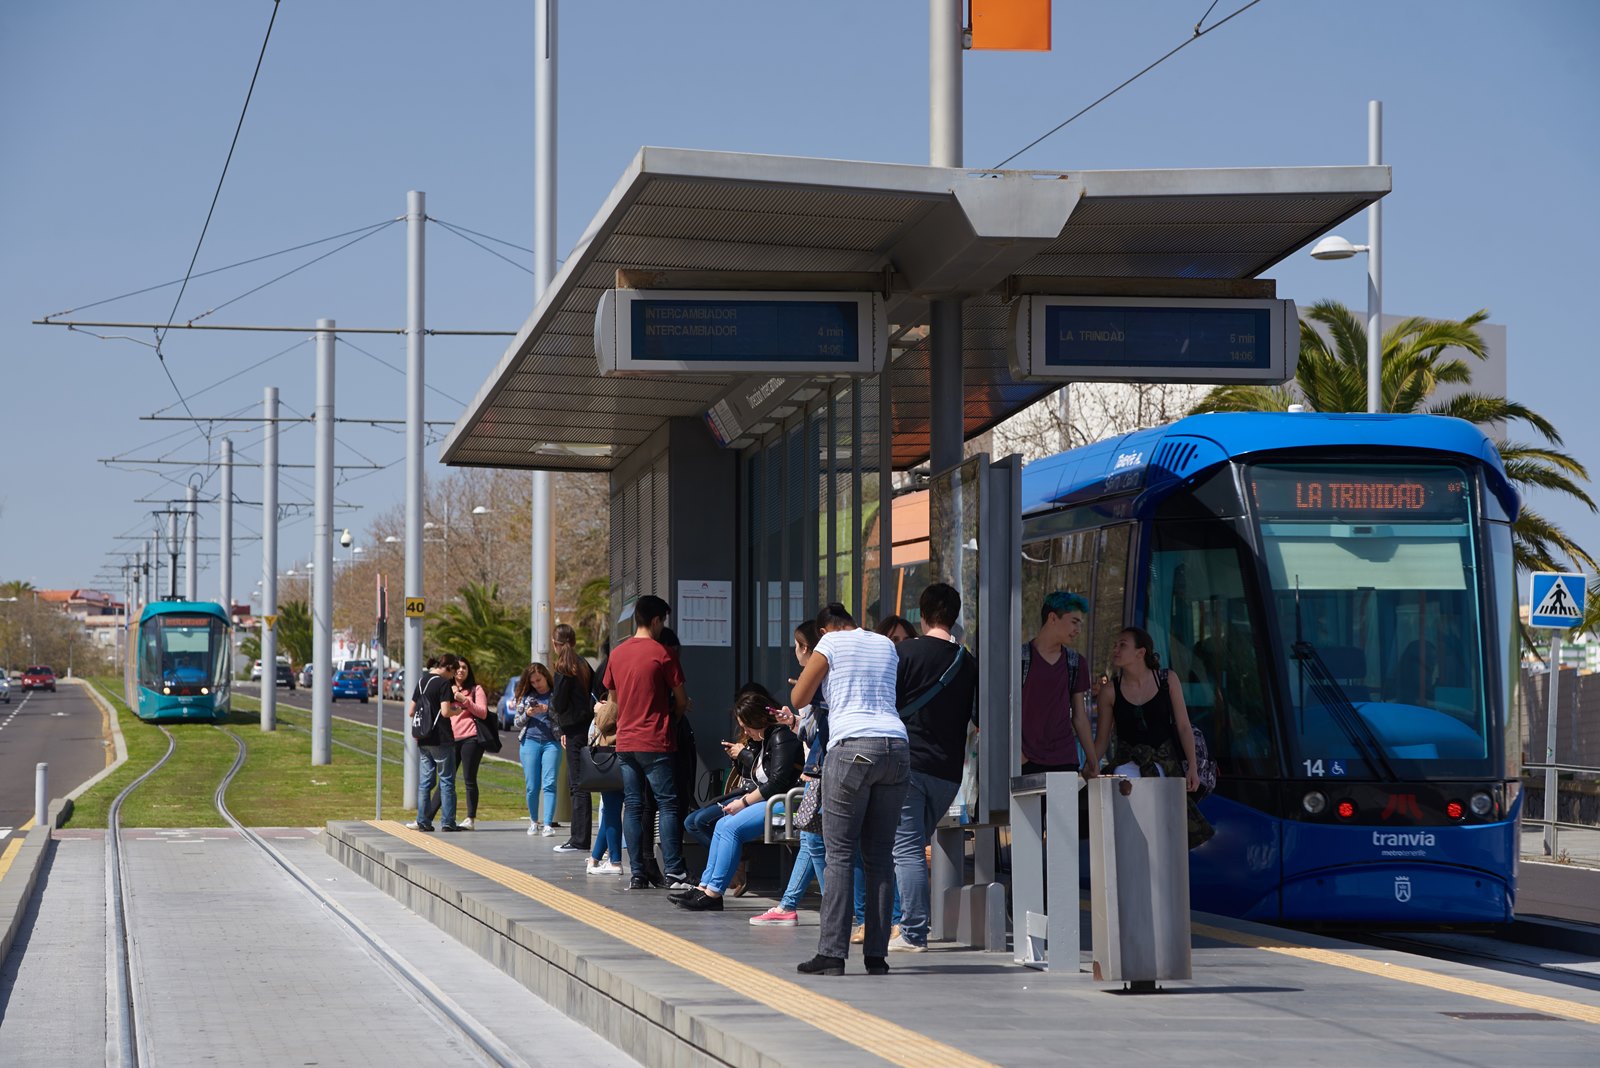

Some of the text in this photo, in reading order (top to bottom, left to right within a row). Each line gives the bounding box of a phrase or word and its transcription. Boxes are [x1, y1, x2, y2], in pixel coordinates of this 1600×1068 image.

[645, 308, 737, 320] INTERCAMBIADOR
[645, 325, 844, 337] INTERCAMBIADOR 4 min
[1059, 330, 1073, 341] LA
[1079, 330, 1125, 342] TRINIDAD
[1238, 333, 1255, 344] min
[1296, 482, 1425, 509] LA TRINIDAD
[406, 601, 425, 613] 40
[1302, 759, 1325, 777] 14
